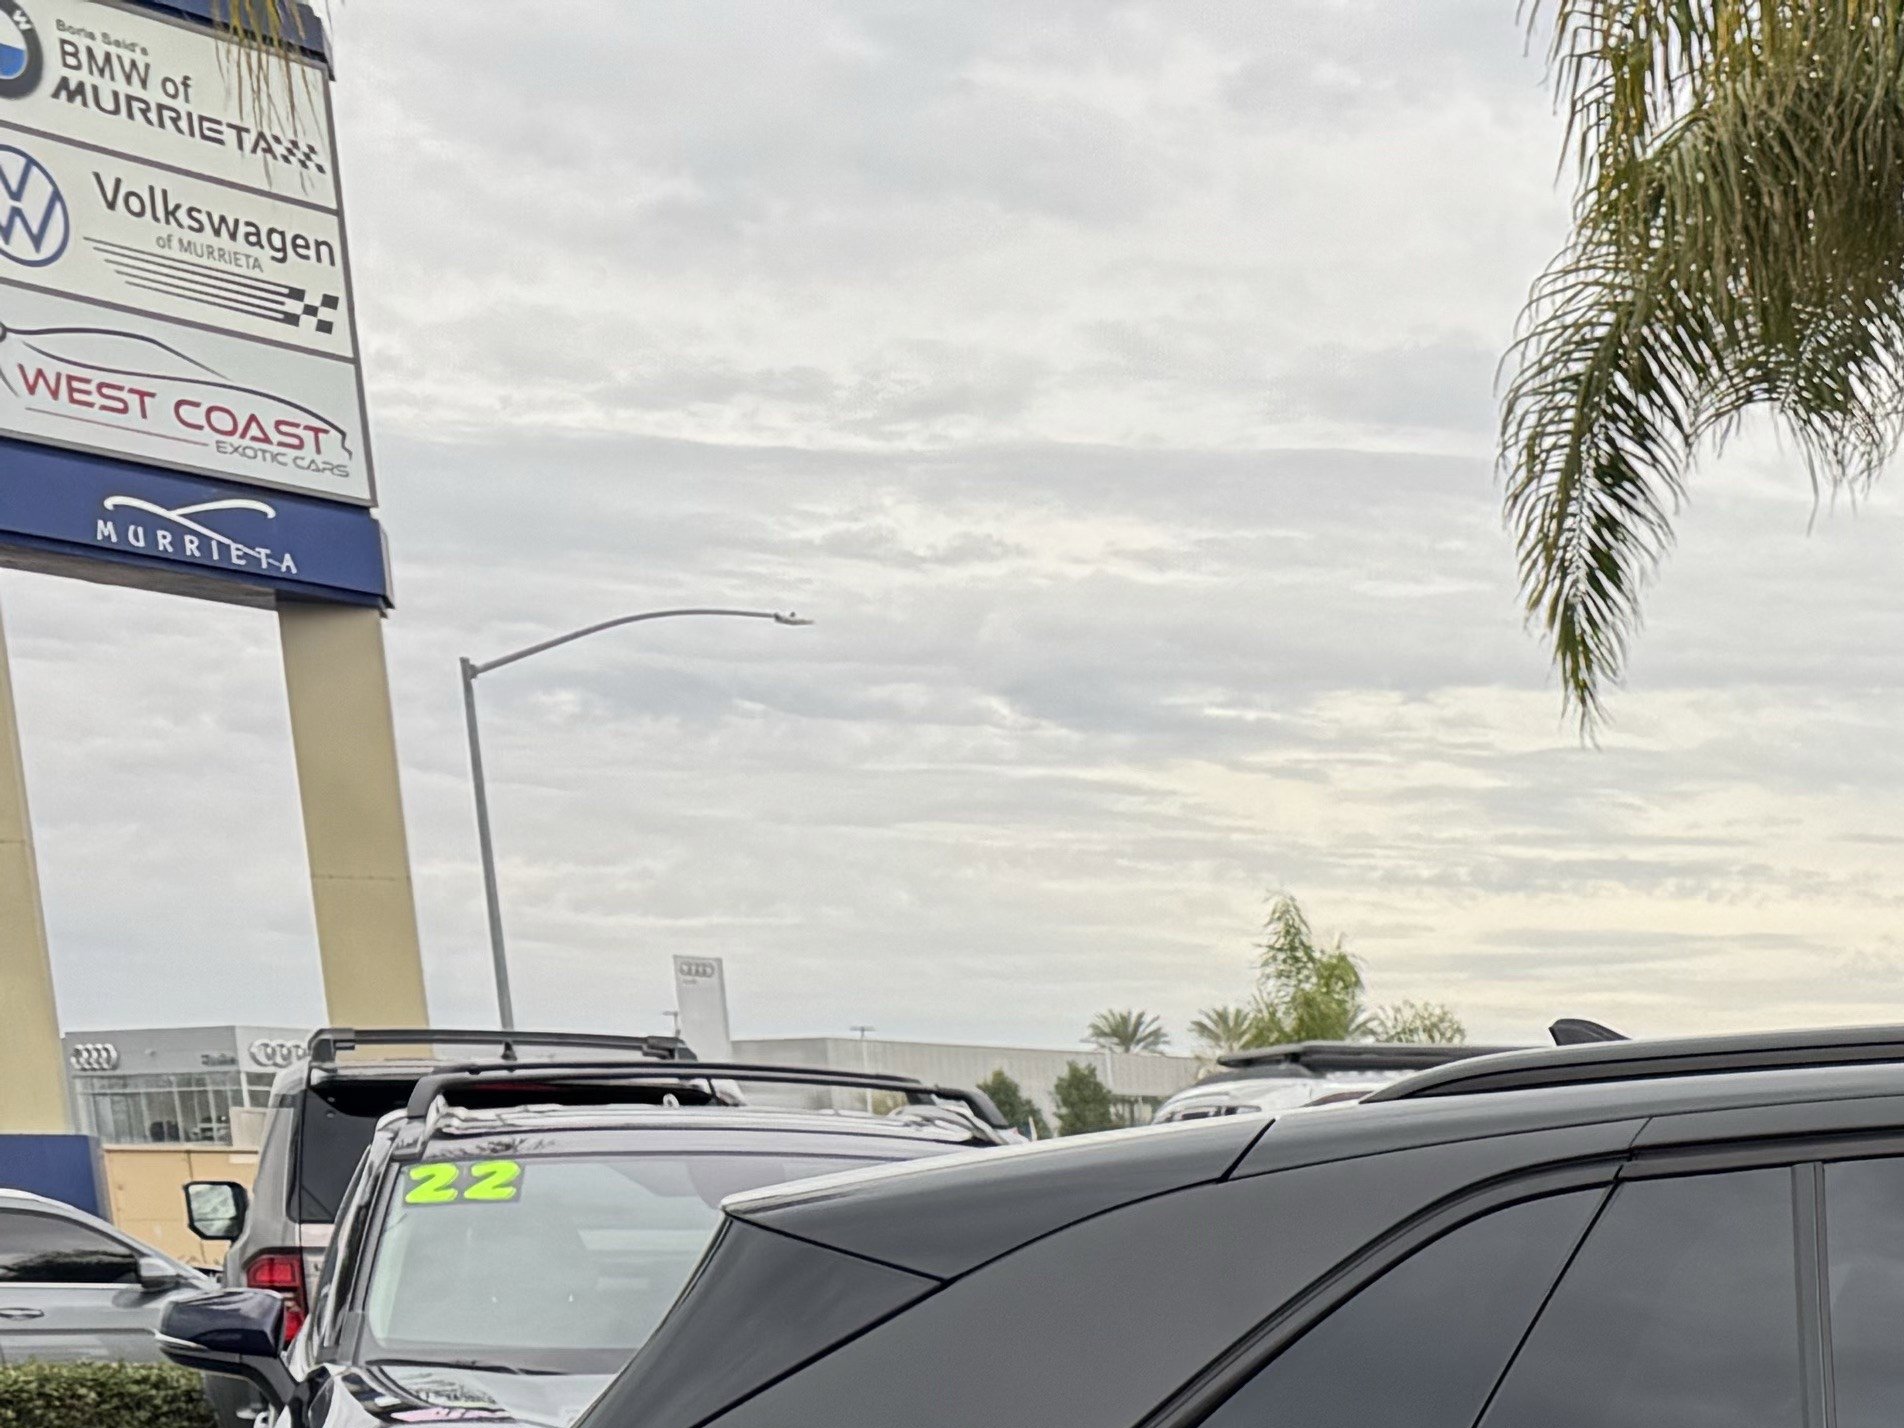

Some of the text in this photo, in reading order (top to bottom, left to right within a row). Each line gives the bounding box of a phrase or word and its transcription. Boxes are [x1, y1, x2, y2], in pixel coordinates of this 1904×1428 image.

[59, 38, 192, 104] BMW of
[51, 76, 279, 161] MURRIETA
[92, 171, 337, 267] Volkswagen
[156, 234, 264, 272] of MURRIETA
[18, 363, 330, 455] WEST COAST
[216, 440, 349, 478] EXOTIC CARS
[96, 519, 298, 574] MURRIETA
[404, 1160, 521, 1204] 22
